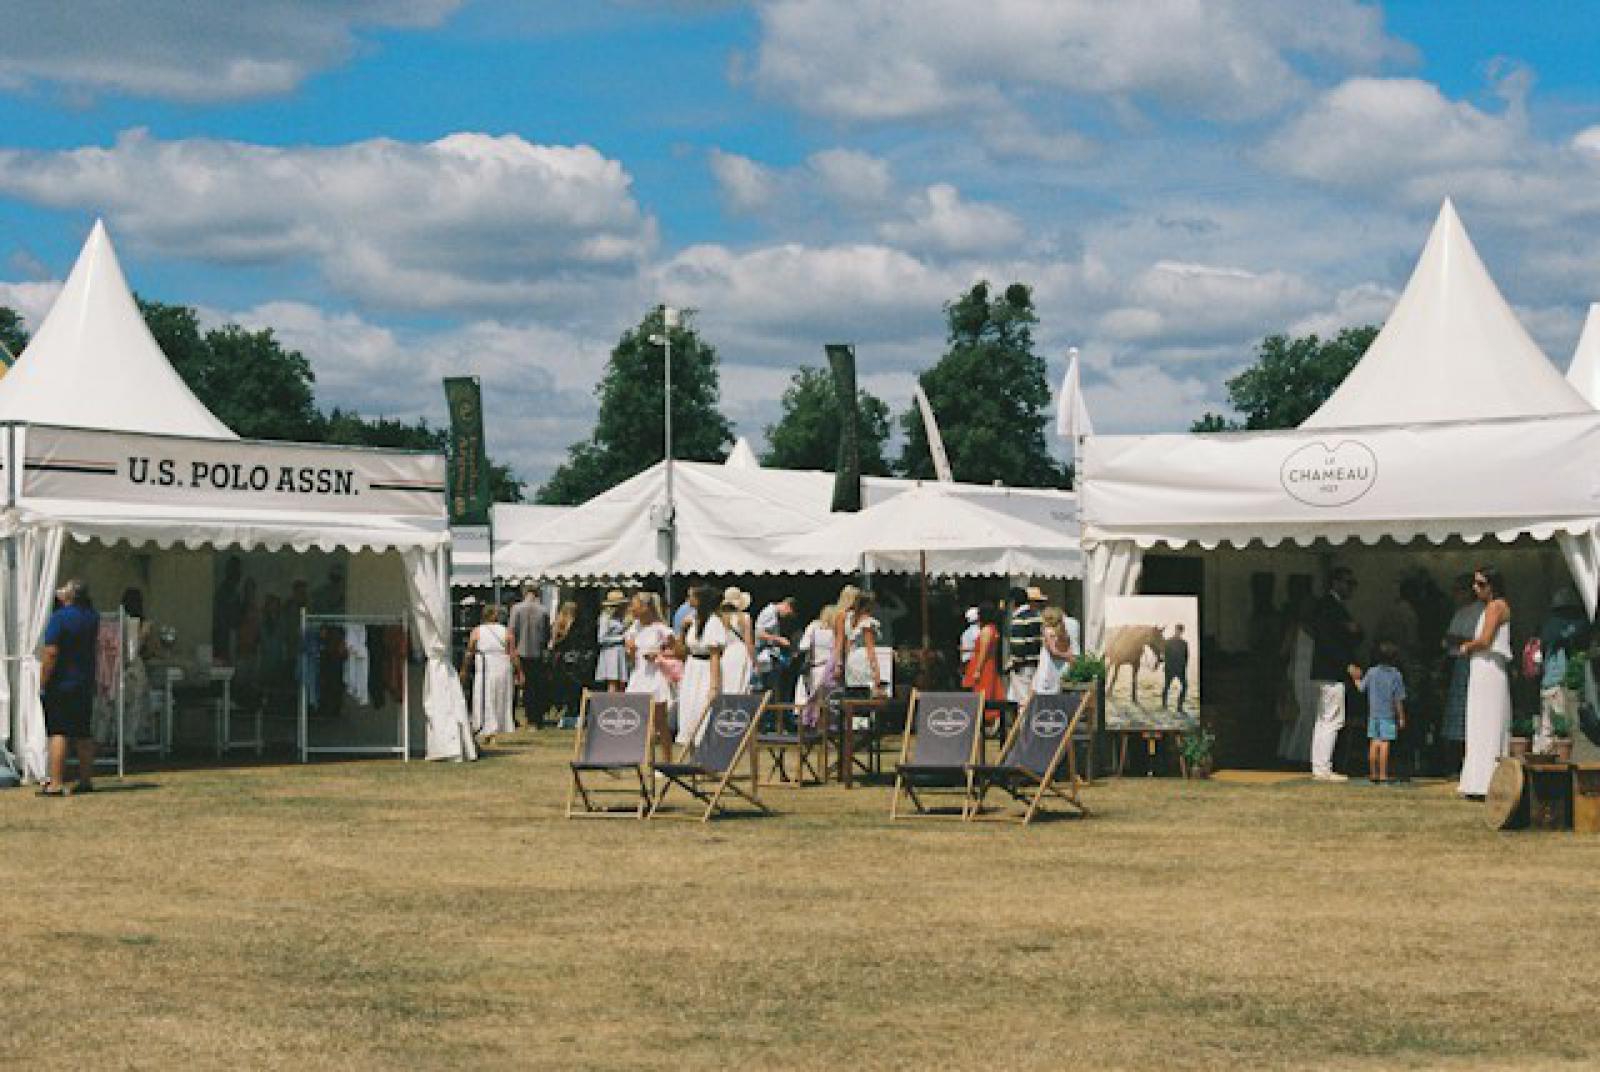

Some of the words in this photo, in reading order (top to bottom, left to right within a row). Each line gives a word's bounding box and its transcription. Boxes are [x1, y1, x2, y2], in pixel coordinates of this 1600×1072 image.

[127, 457, 183, 486] U.S.
[190, 462, 270, 490] POLO
[275, 467, 359, 496] ASSN.
[1289, 466, 1369, 483] CHAMEAU
